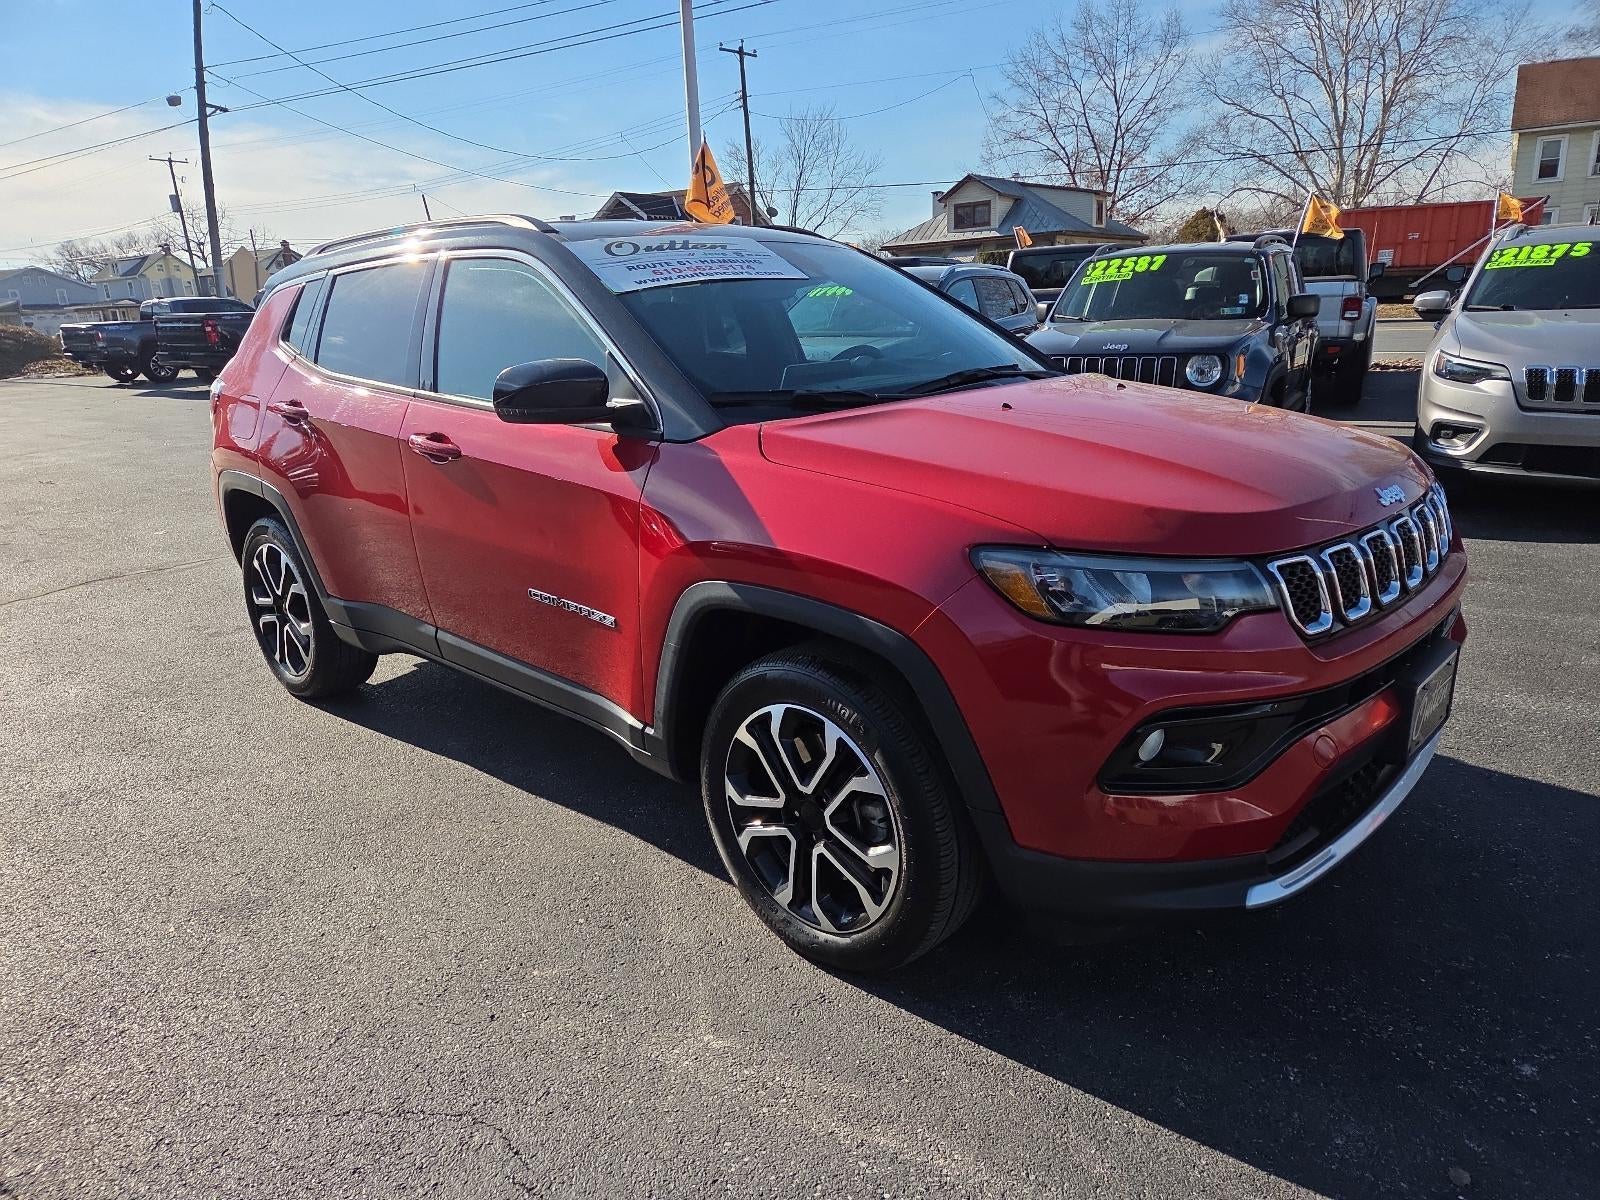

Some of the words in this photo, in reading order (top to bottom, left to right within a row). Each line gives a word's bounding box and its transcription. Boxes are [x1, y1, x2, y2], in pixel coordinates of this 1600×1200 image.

[1491, 242, 1593, 263] $21875
[625, 261, 675, 272] ROUTE
[1086, 254, 1168, 277] $22587
[1102, 342, 1129, 352] Jeep
[1374, 484, 1406, 507] Jeep
[527, 587, 616, 628] COMPASS
